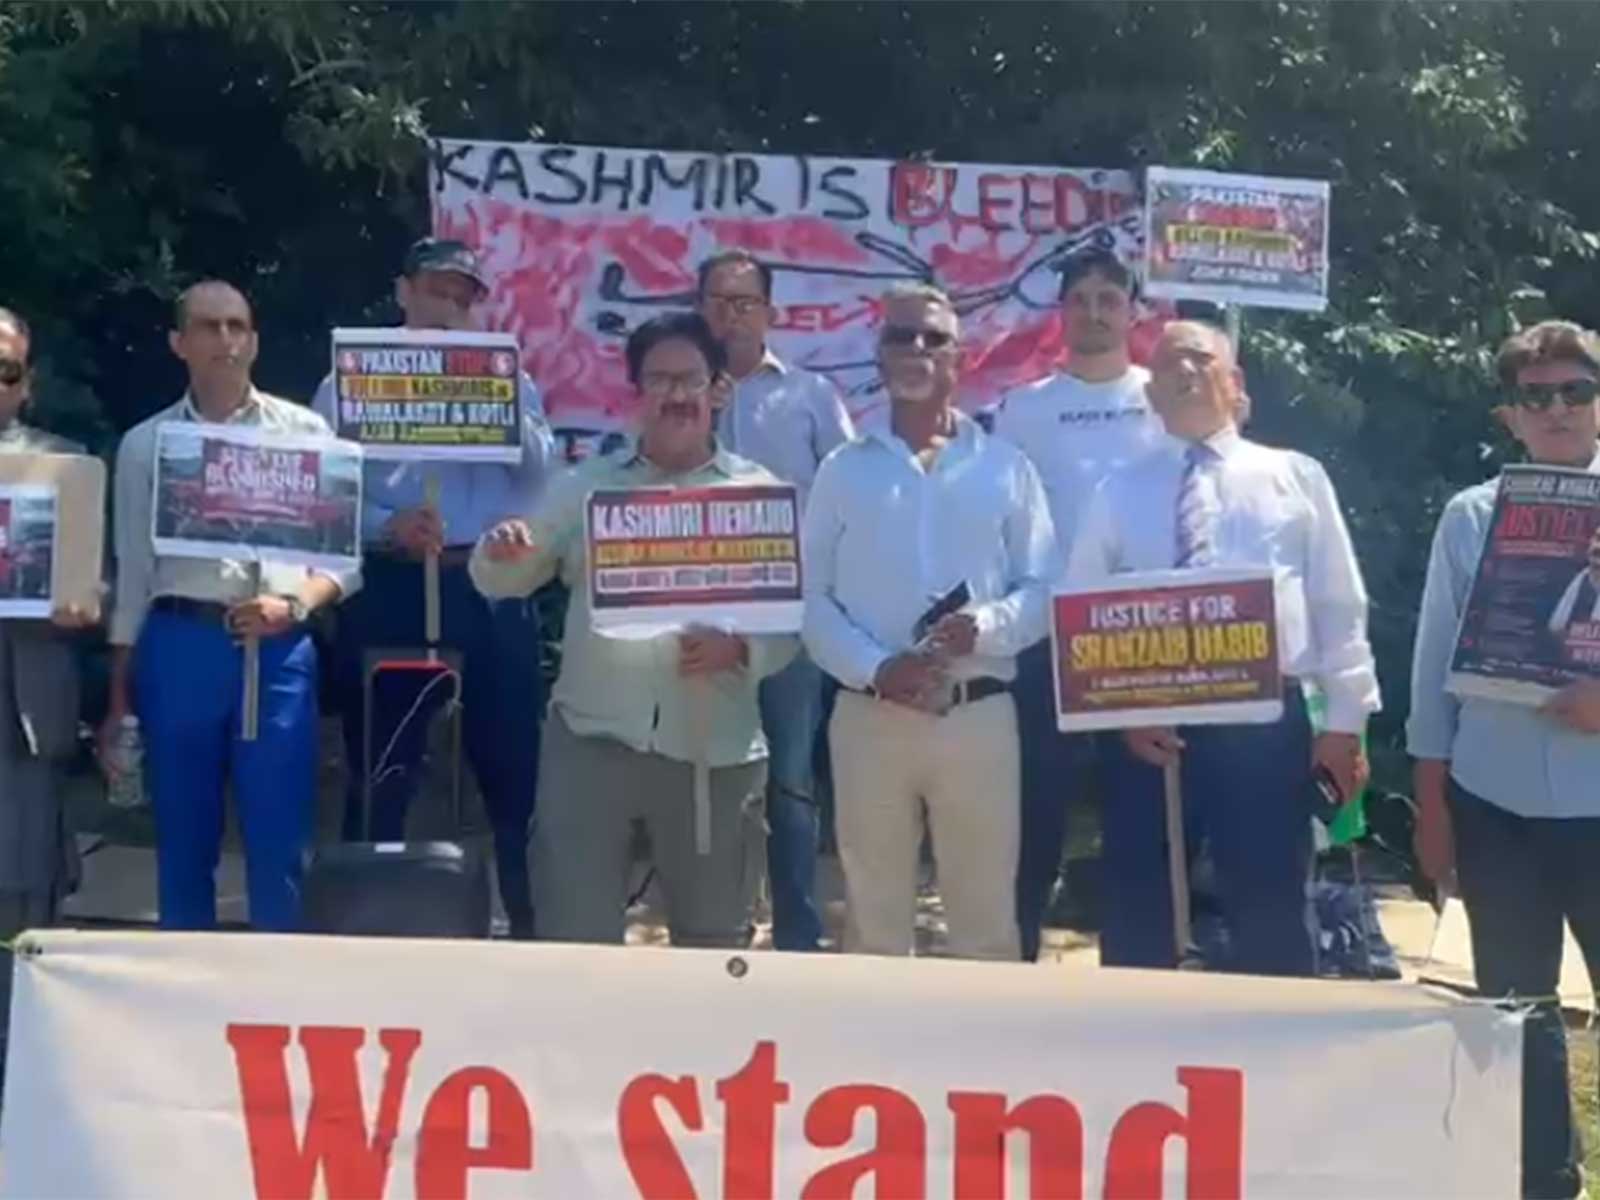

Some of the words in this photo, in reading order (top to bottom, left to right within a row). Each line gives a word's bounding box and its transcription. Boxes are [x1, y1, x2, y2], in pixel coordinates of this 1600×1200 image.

[433, 138, 776, 215] KASHMIR
[796, 155, 869, 220] IS
[361, 350, 443, 375] PAKISTAN
[593, 502, 702, 540] KASHMIRI
[1091, 600, 1184, 628] JUSTICE
[1189, 595, 1237, 621] FOR
[226, 1023, 533, 1200] We
[618, 1040, 1243, 1200] stand
